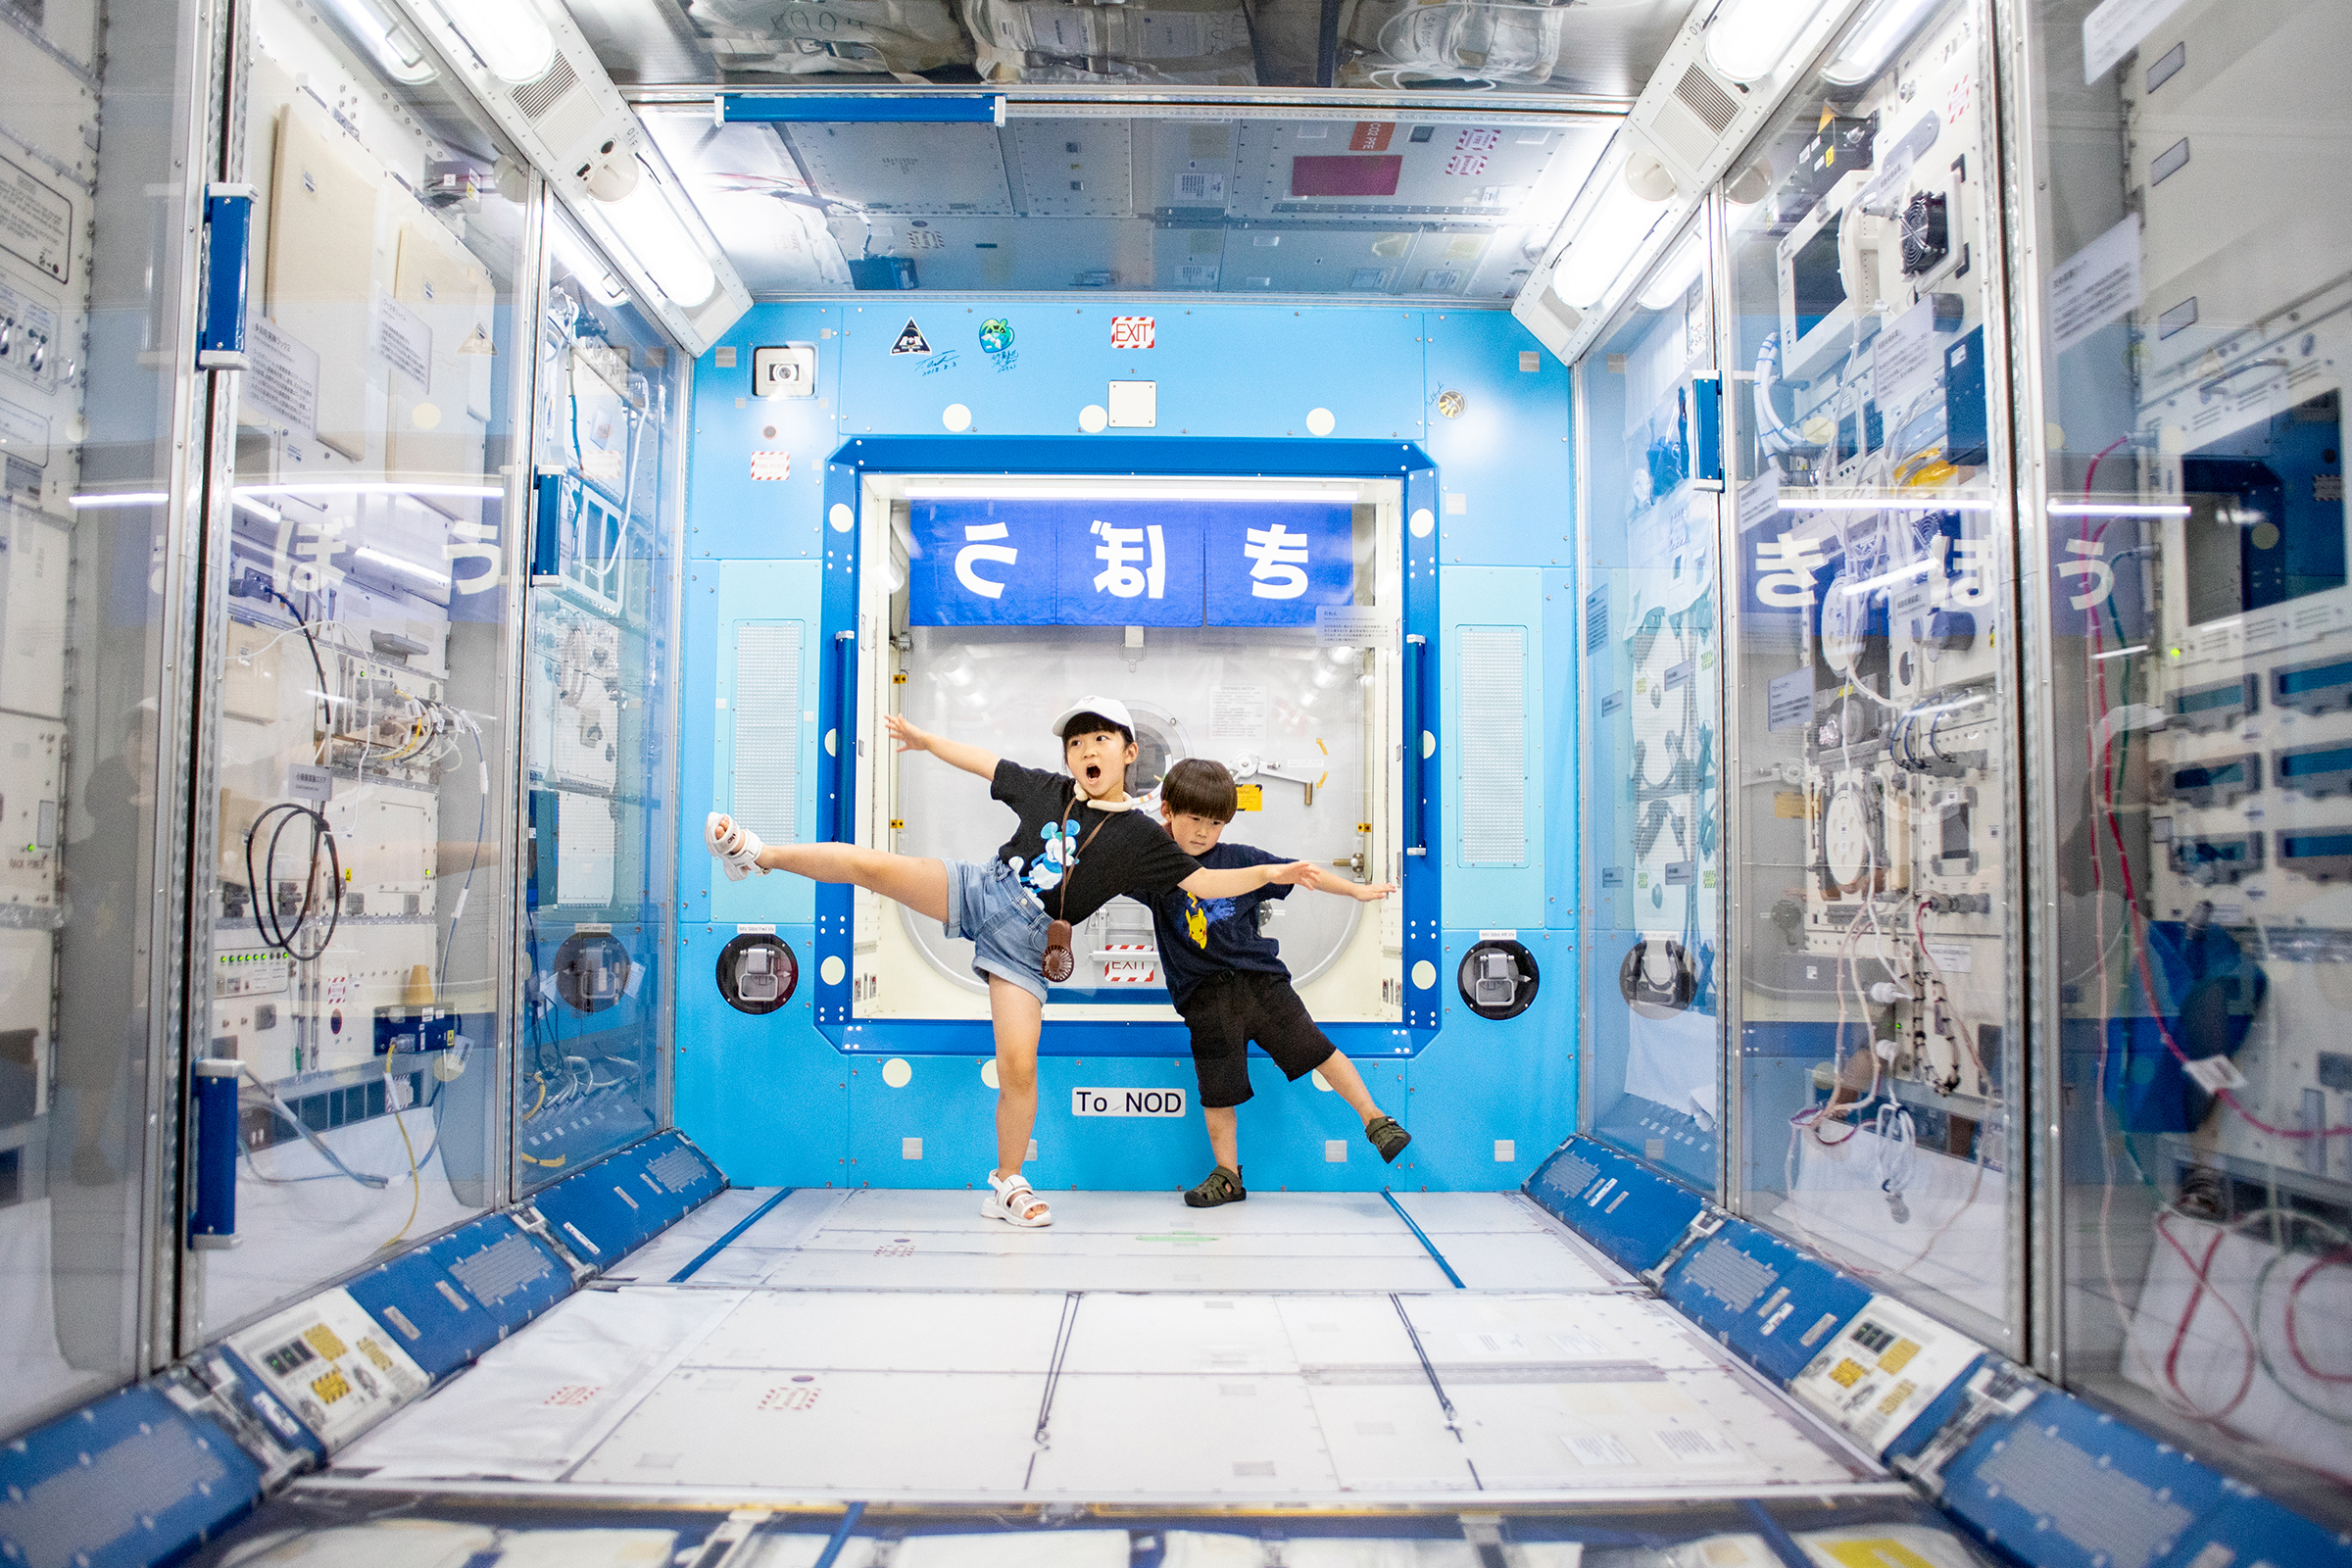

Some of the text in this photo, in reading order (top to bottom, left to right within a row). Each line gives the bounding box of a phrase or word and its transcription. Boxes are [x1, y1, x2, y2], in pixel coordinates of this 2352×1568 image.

[1362, 122, 1381, 150] CO2 PFE
[1115, 323, 1150, 342] EXIT
[1076, 1092, 1182, 1113] To NOD
